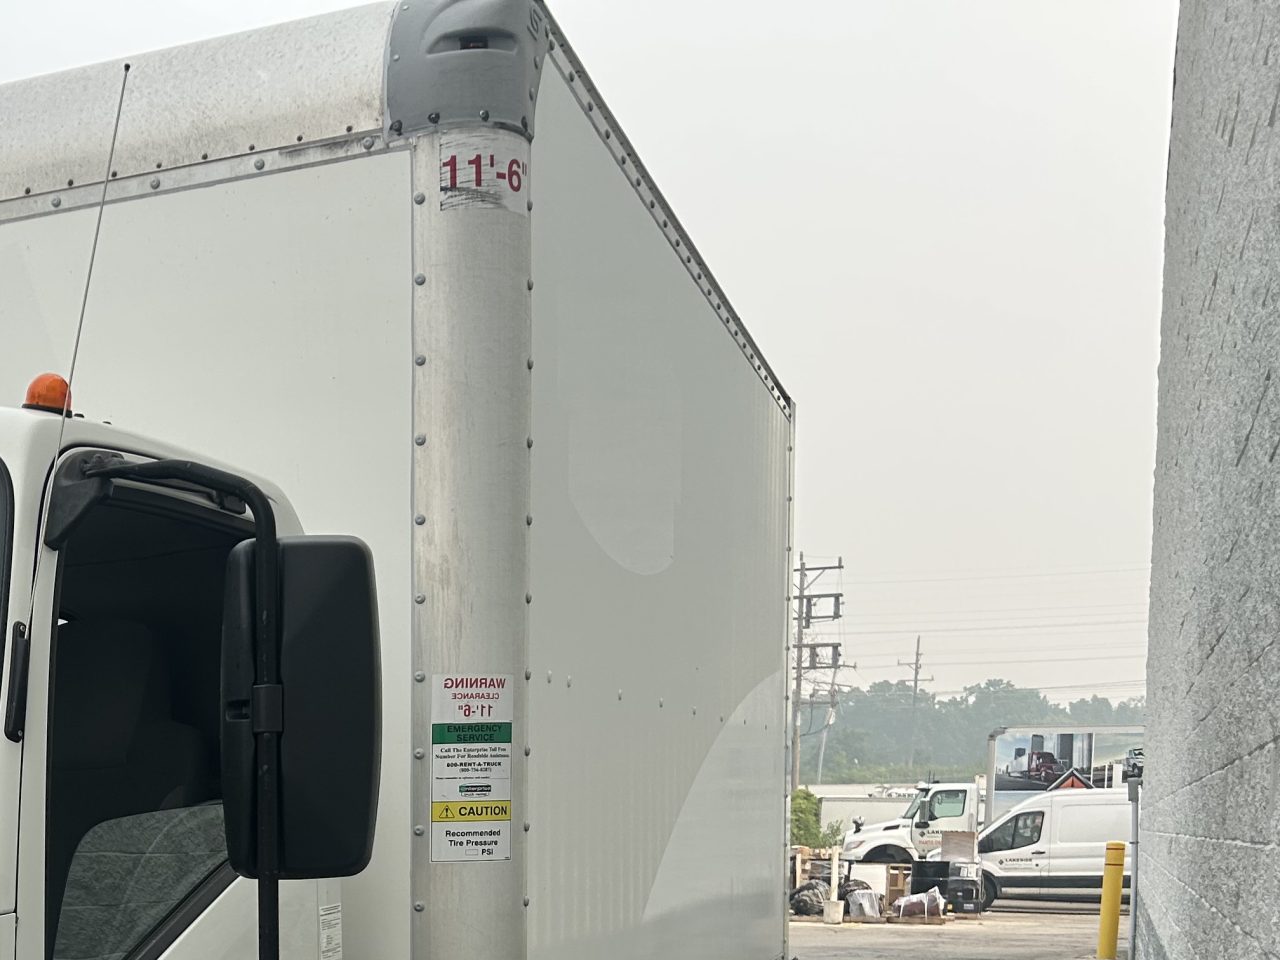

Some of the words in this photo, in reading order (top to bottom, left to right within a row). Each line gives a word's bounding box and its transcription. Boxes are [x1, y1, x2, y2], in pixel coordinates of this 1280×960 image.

[442, 154, 527, 192] 11'-6"
[447, 725, 502, 733] EMERGENCY
[456, 733, 495, 742] SERVICE
[458, 806, 508, 817] CAUTION
[445, 829, 501, 837] Recommended
[481, 848, 494, 856] PSI
